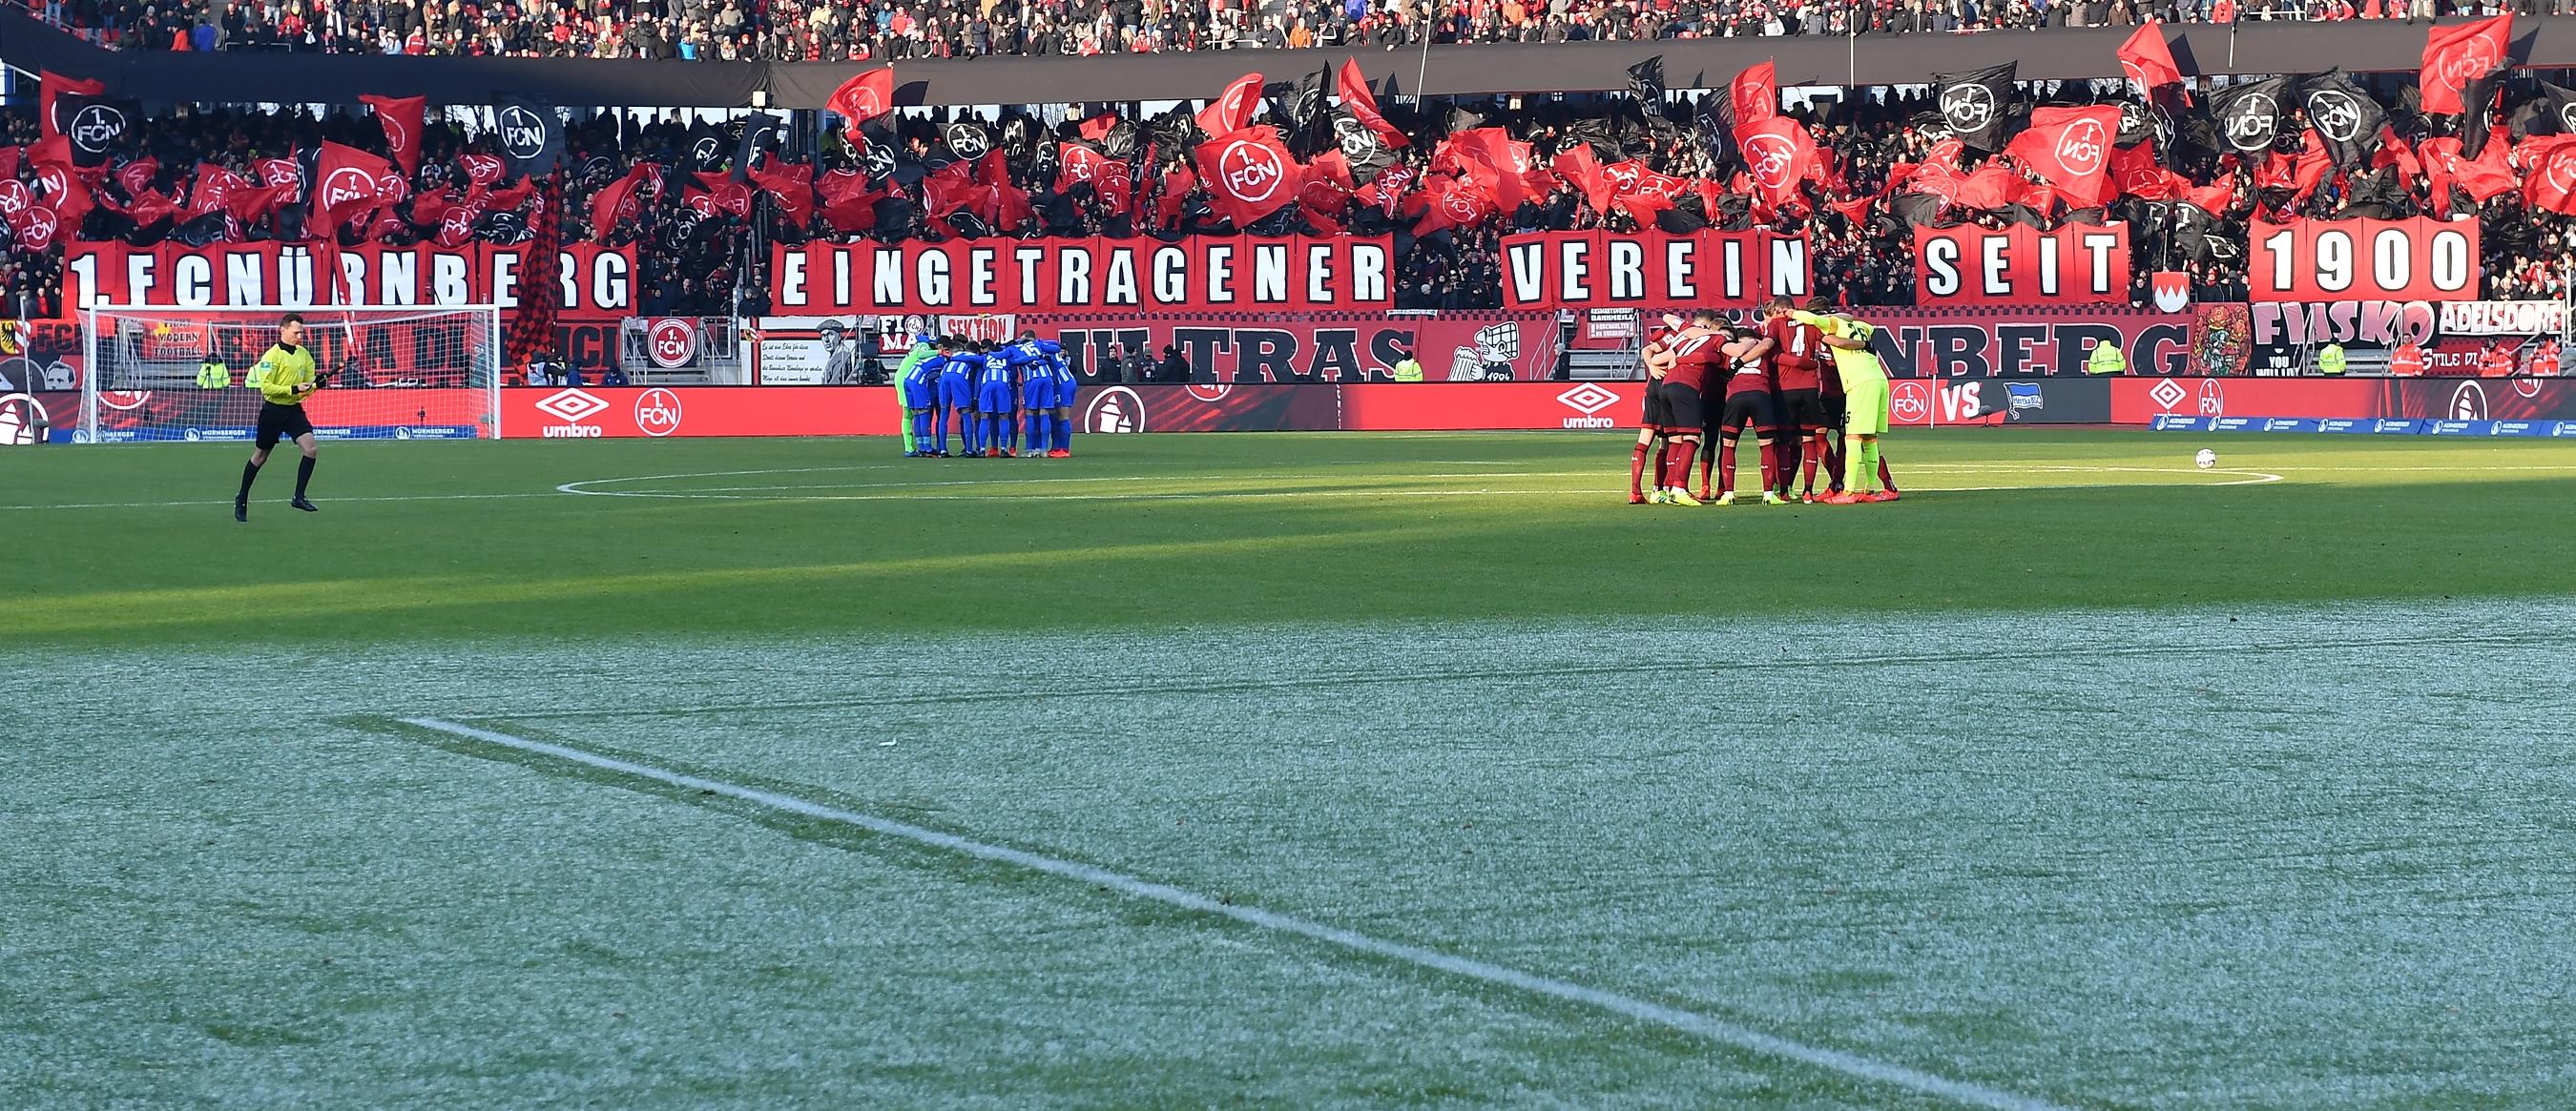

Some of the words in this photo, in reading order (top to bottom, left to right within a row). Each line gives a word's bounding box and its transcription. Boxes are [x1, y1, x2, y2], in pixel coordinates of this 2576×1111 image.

[2319, 102, 2358, 134] FCN
[77, 122, 120, 142] FCN
[507, 126, 542, 147] FCN
[952, 135, 986, 153] FCN
[1237, 147, 1255, 165] 1.
[1755, 144, 1792, 180] FCN
[348, 175, 358, 190] 1.
[1230, 158, 1277, 191] FCN
[22, 220, 54, 242] FCN
[1509, 239, 1804, 301] VEREIN
[1926, 235, 2116, 296] SEIT
[2266, 229, 2466, 291] 1900
[783, 244, 1385, 306] EINGETRAGENER
[2252, 301, 2435, 346] FIASKO
[2441, 301, 2565, 333] ADELSDORF
[668, 330, 677, 340] 1.
[947, 318, 1008, 342] SEKTION
[1789, 323, 1806, 357] 4
[154, 346, 202, 357] FOOTBALL
[658, 340, 684, 354] FCN
[2269, 357, 2290, 368] YOU
[2422, 348, 2461, 370] STILE
[653, 392, 663, 407] 1.
[1894, 398, 1925, 412] FCN
[1941, 381, 1982, 422] VS
[2201, 399, 2221, 415] FCN
[640, 407, 675, 424] FCN
[1563, 415, 1614, 428] umbro
[543, 423, 602, 438] umbro
